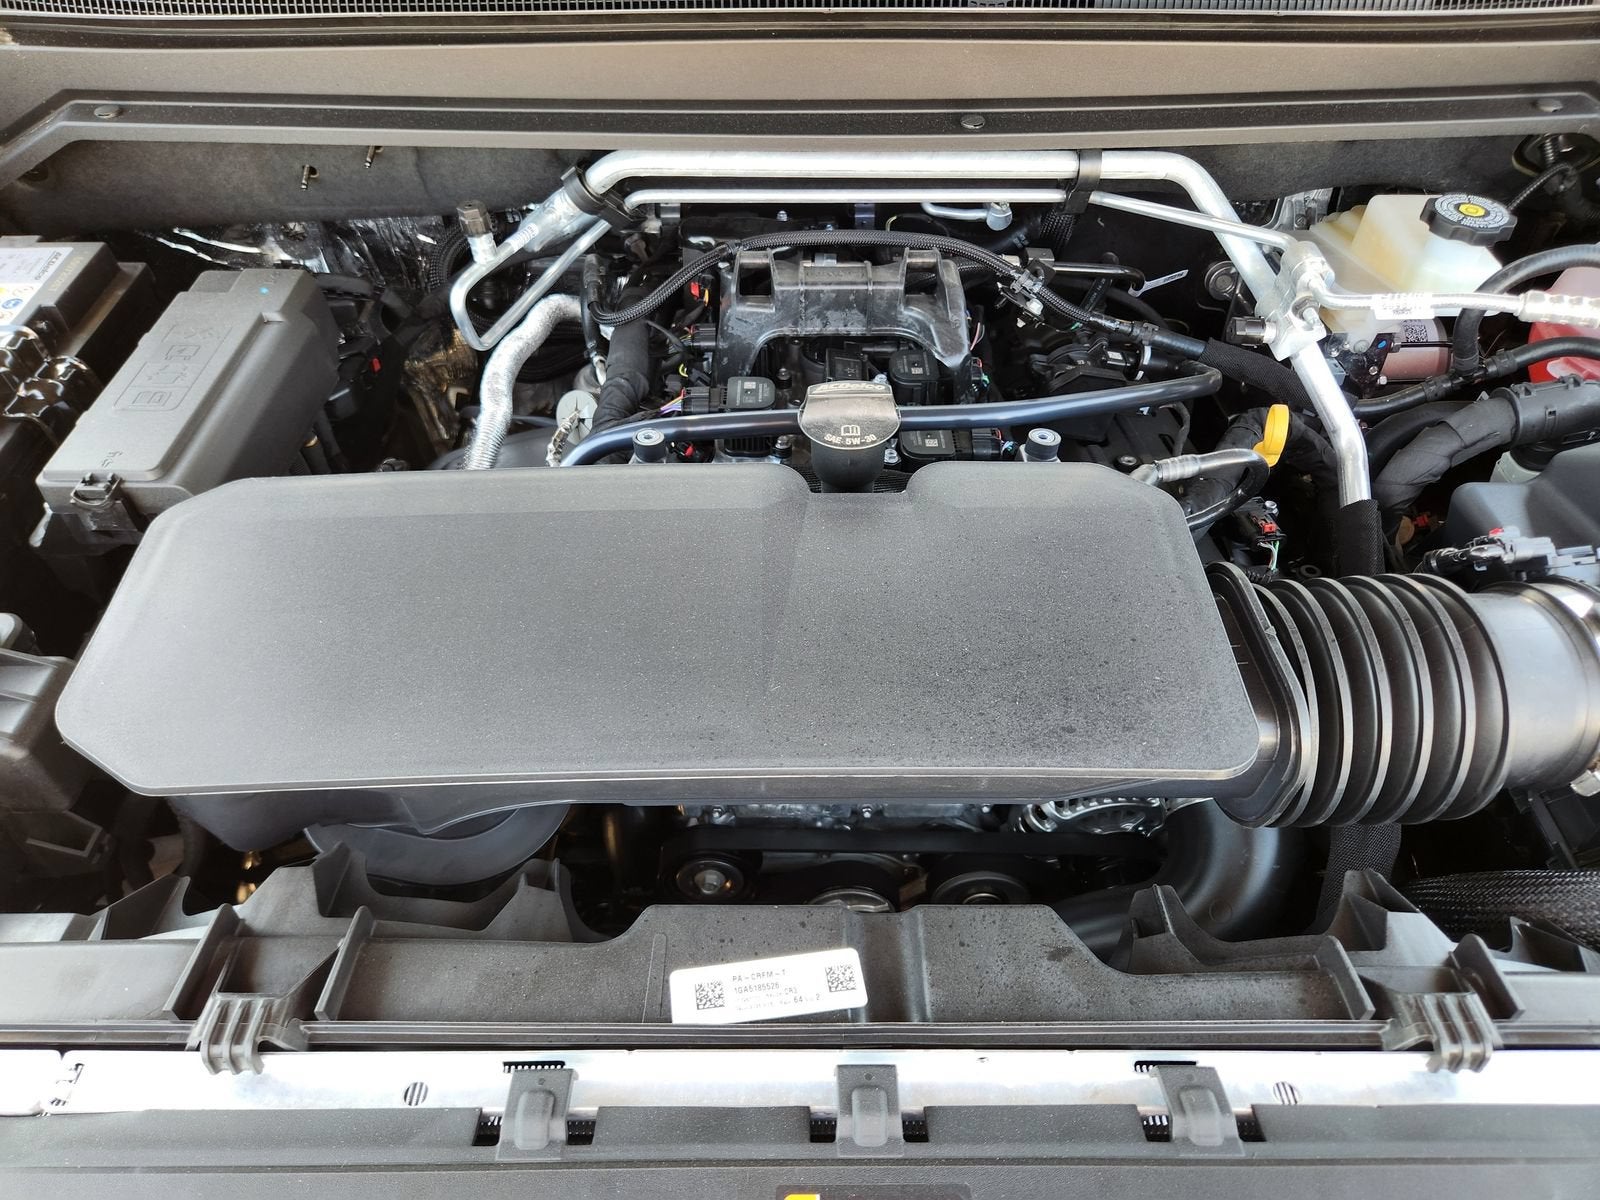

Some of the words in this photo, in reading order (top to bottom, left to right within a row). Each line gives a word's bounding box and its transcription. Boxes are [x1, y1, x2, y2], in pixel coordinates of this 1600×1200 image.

[812, 383, 885, 393] ACDelco
[824, 433, 842, 444] SAE
[845, 434, 877, 445] 5W-30
